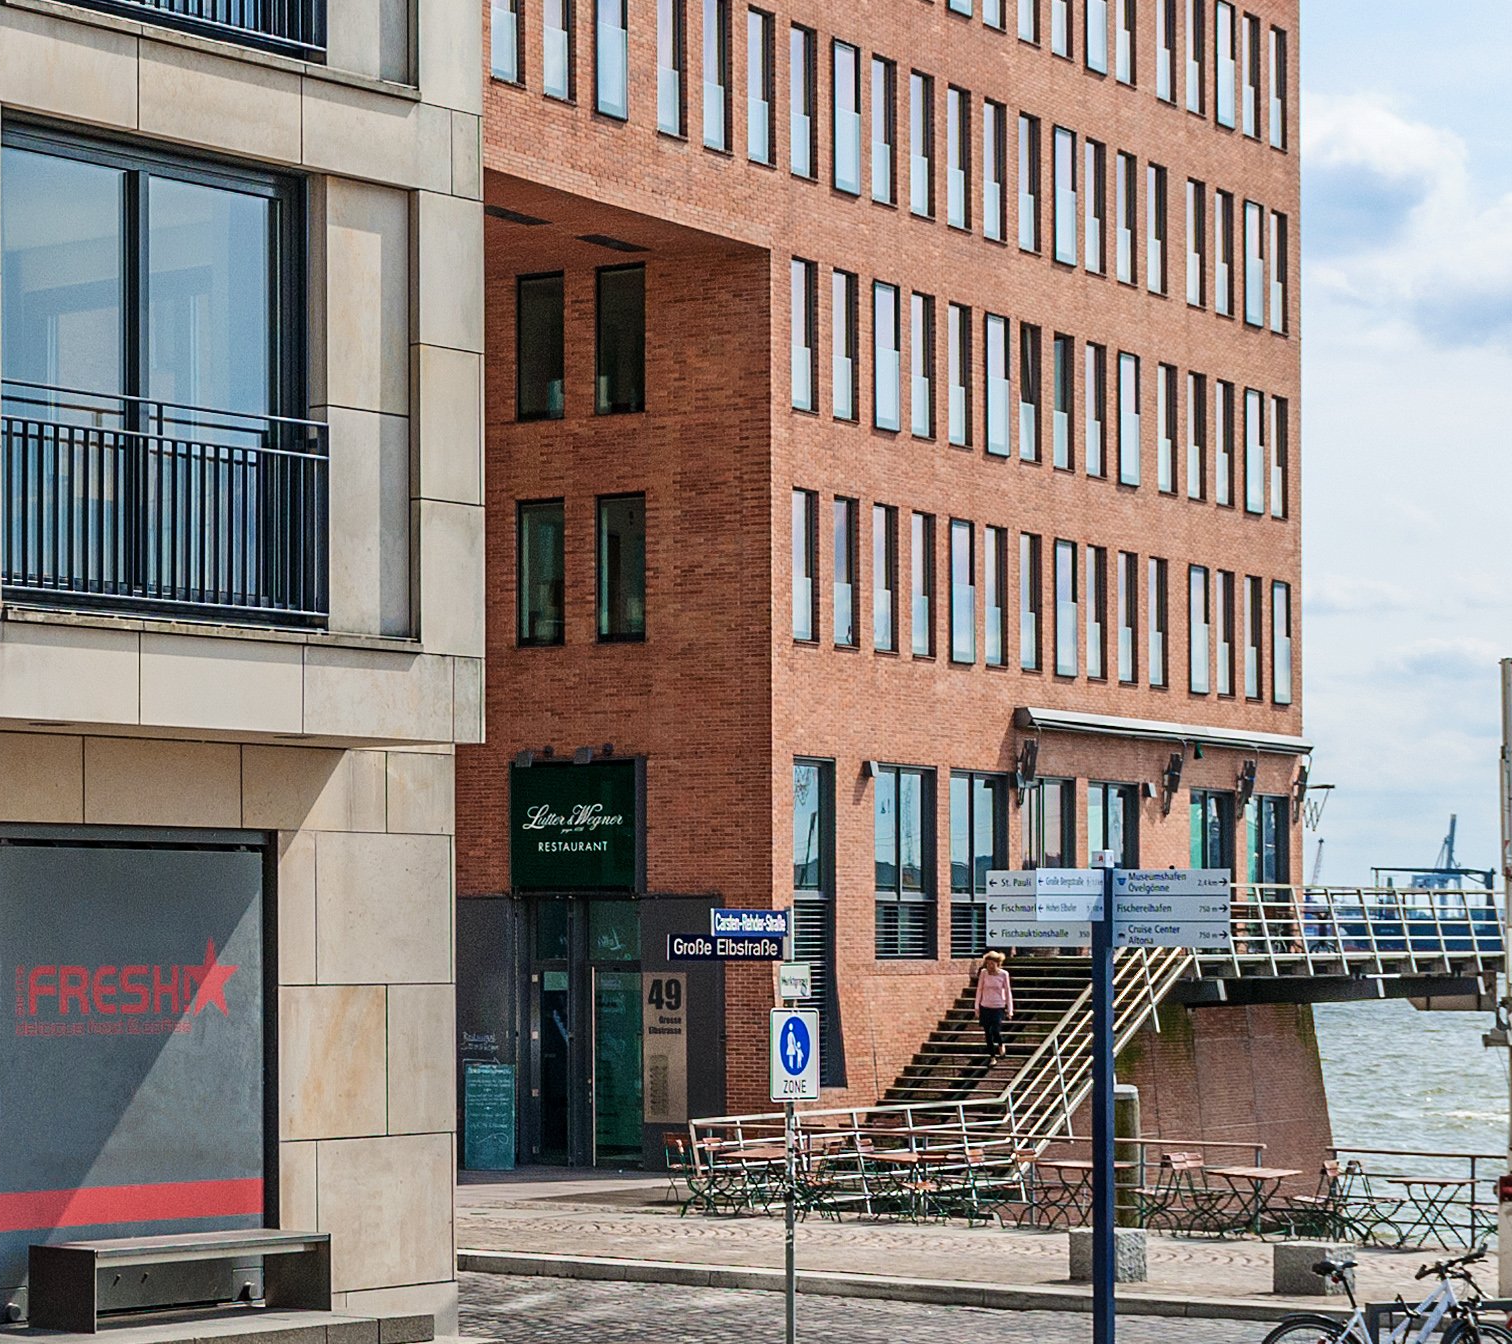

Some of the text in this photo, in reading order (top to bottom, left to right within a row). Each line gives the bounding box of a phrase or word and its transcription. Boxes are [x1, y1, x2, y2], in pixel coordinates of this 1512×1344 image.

[522, 804, 565, 829] Lutter
[572, 803, 624, 831] Wegner
[538, 841, 608, 852] RESTAURANT
[1128, 872, 1187, 881] Museumshafen
[1001, 878, 1032, 887] St. Pauli
[1117, 904, 1172, 913] Fischereihafen
[715, 913, 786, 932] Carsten-Rehder-Straße
[1001, 928, 1069, 938] Fischauktionshalle
[1128, 925, 1152, 934] Cruise
[1154, 925, 1180, 934] Center
[1128, 936, 1154, 945] Altona
[674, 938, 778, 956] Große Elbstraße
[648, 979, 682, 1010] 49
[659, 1015, 682, 1024] Grosse
[783, 1079, 807, 1094] ZONE
